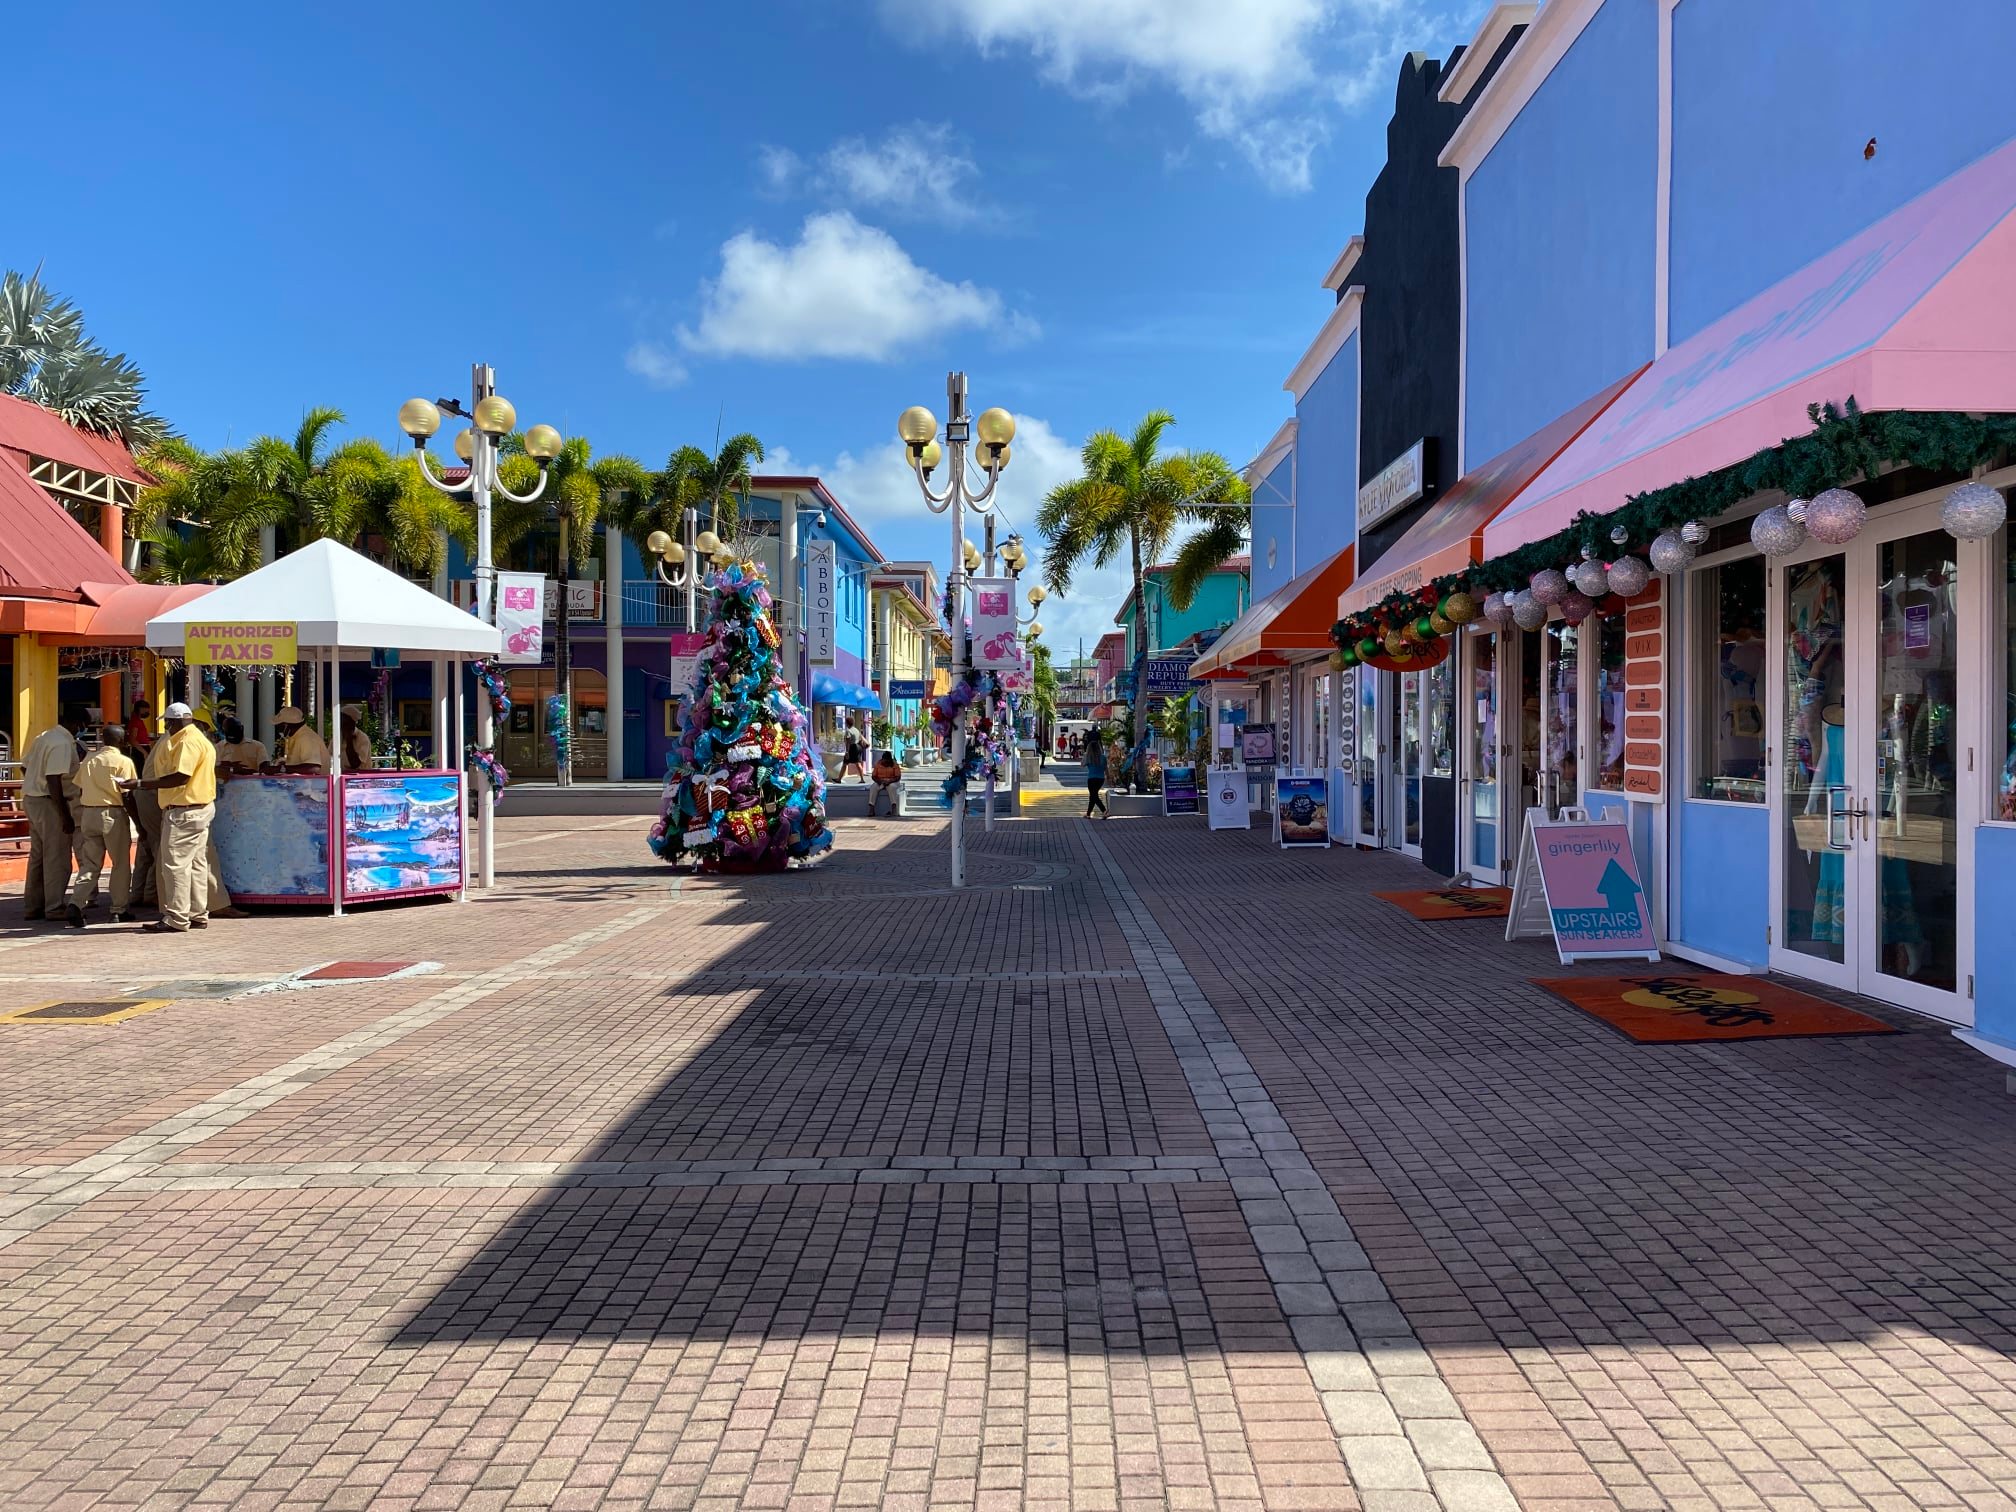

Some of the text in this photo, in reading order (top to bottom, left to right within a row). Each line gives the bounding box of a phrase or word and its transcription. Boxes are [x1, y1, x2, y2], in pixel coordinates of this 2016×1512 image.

[1394, 566, 1422, 590] SHOPPING
[188, 625, 294, 638] AUTHORIZED
[208, 644, 273, 660] TAXIS
[1149, 663, 1190, 672] DIAMO
[1548, 840, 1621, 856] gingerlily
[1555, 911, 1639, 929] UPSTAIRS
